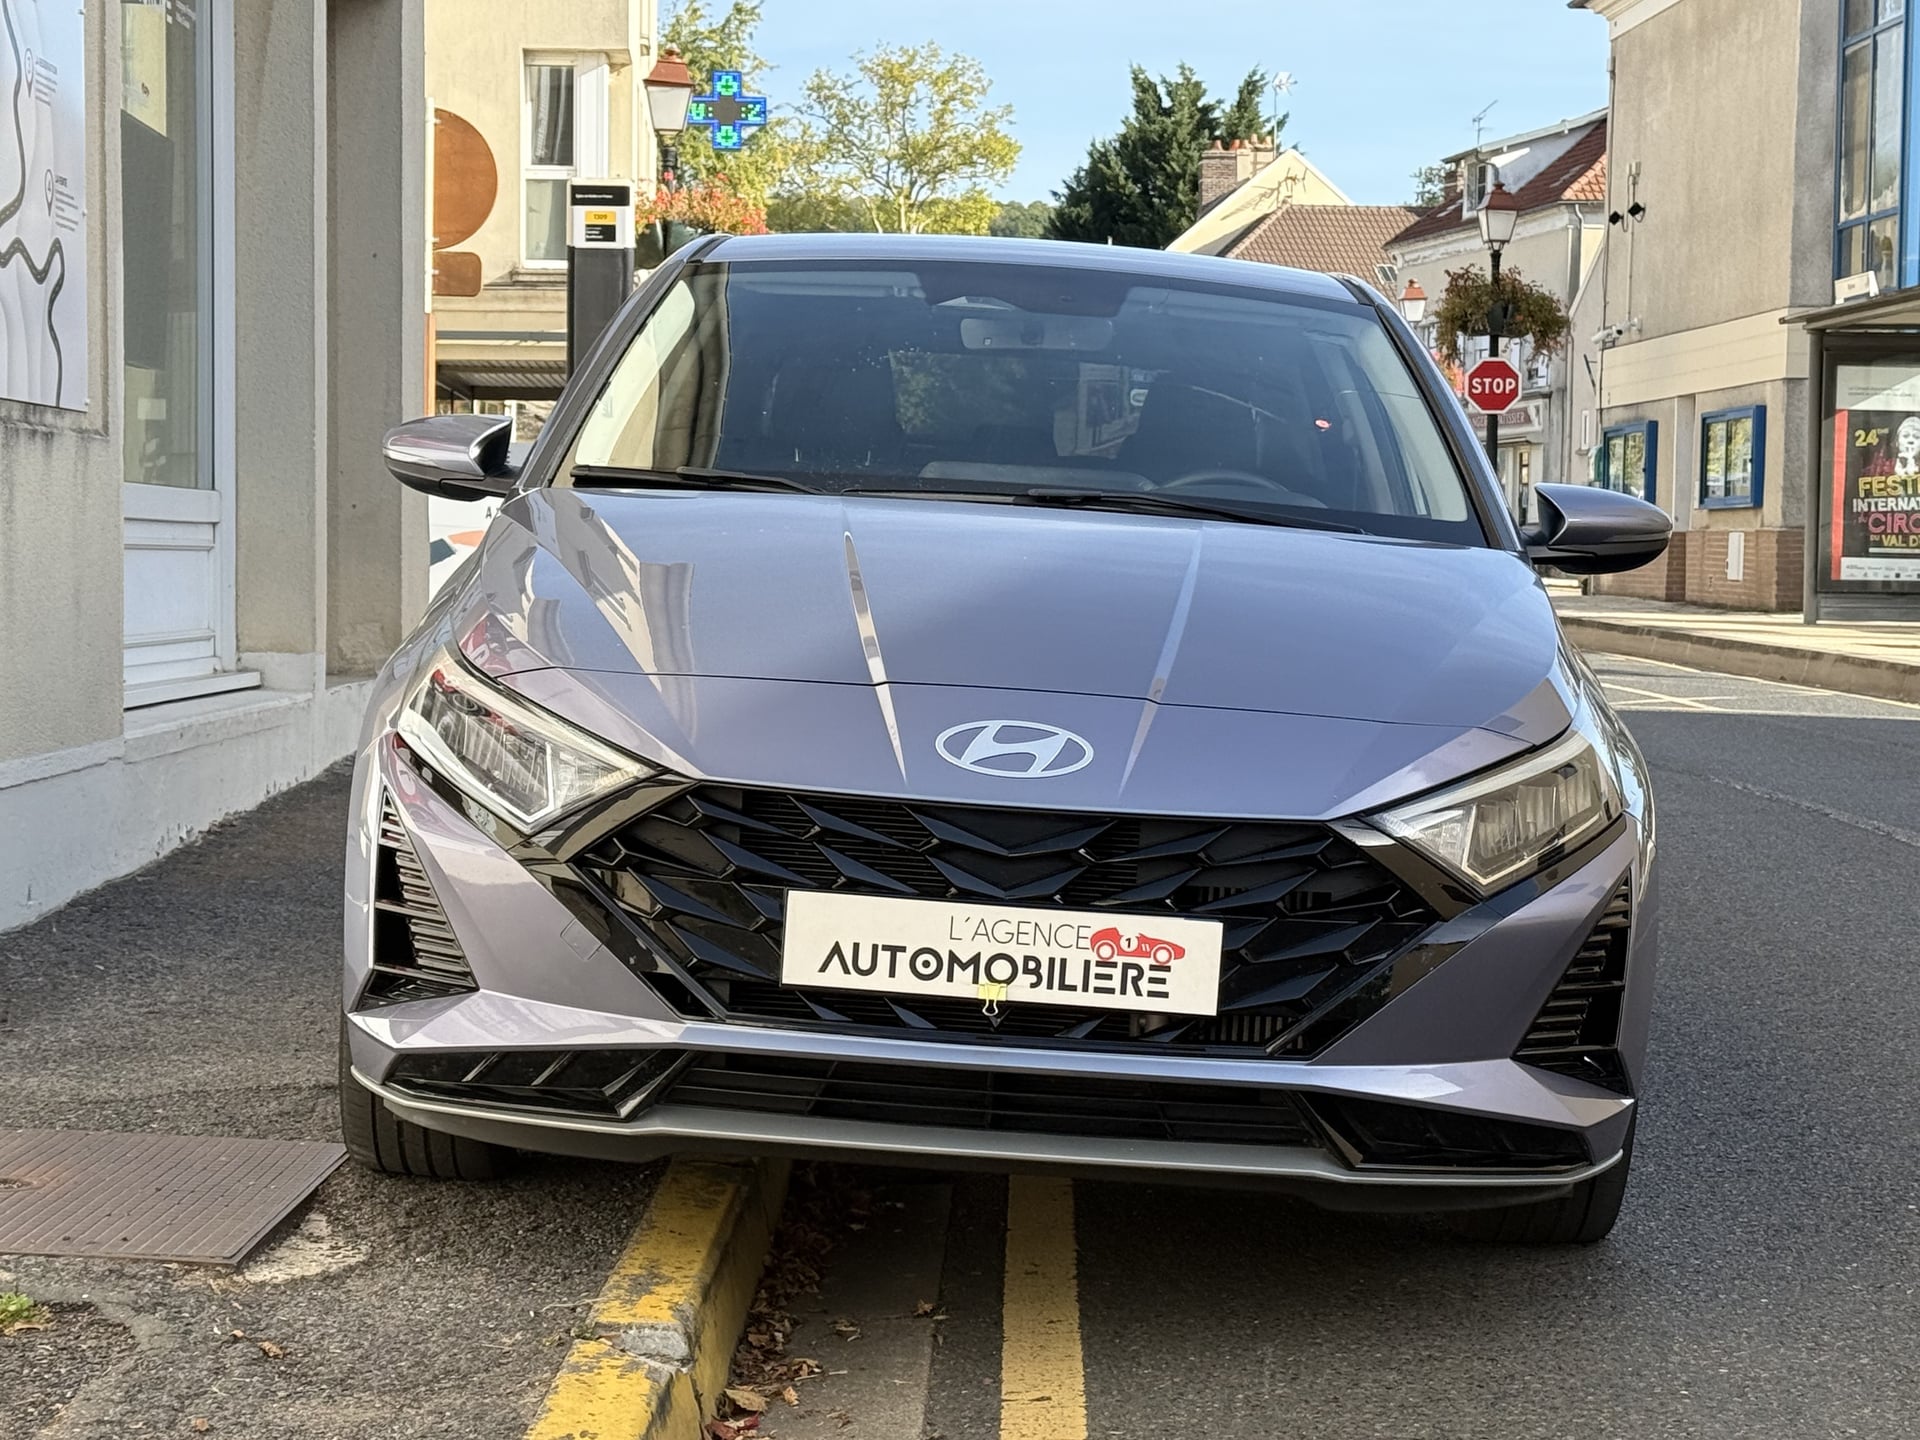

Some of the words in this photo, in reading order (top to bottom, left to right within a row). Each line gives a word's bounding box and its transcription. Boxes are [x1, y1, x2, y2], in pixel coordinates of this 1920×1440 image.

[1471, 378, 1516, 394] STOP
[1881, 535, 1906, 547] VAL
[949, 915, 1091, 950] L'AGENCE
[1125, 938, 1132, 949] 1
